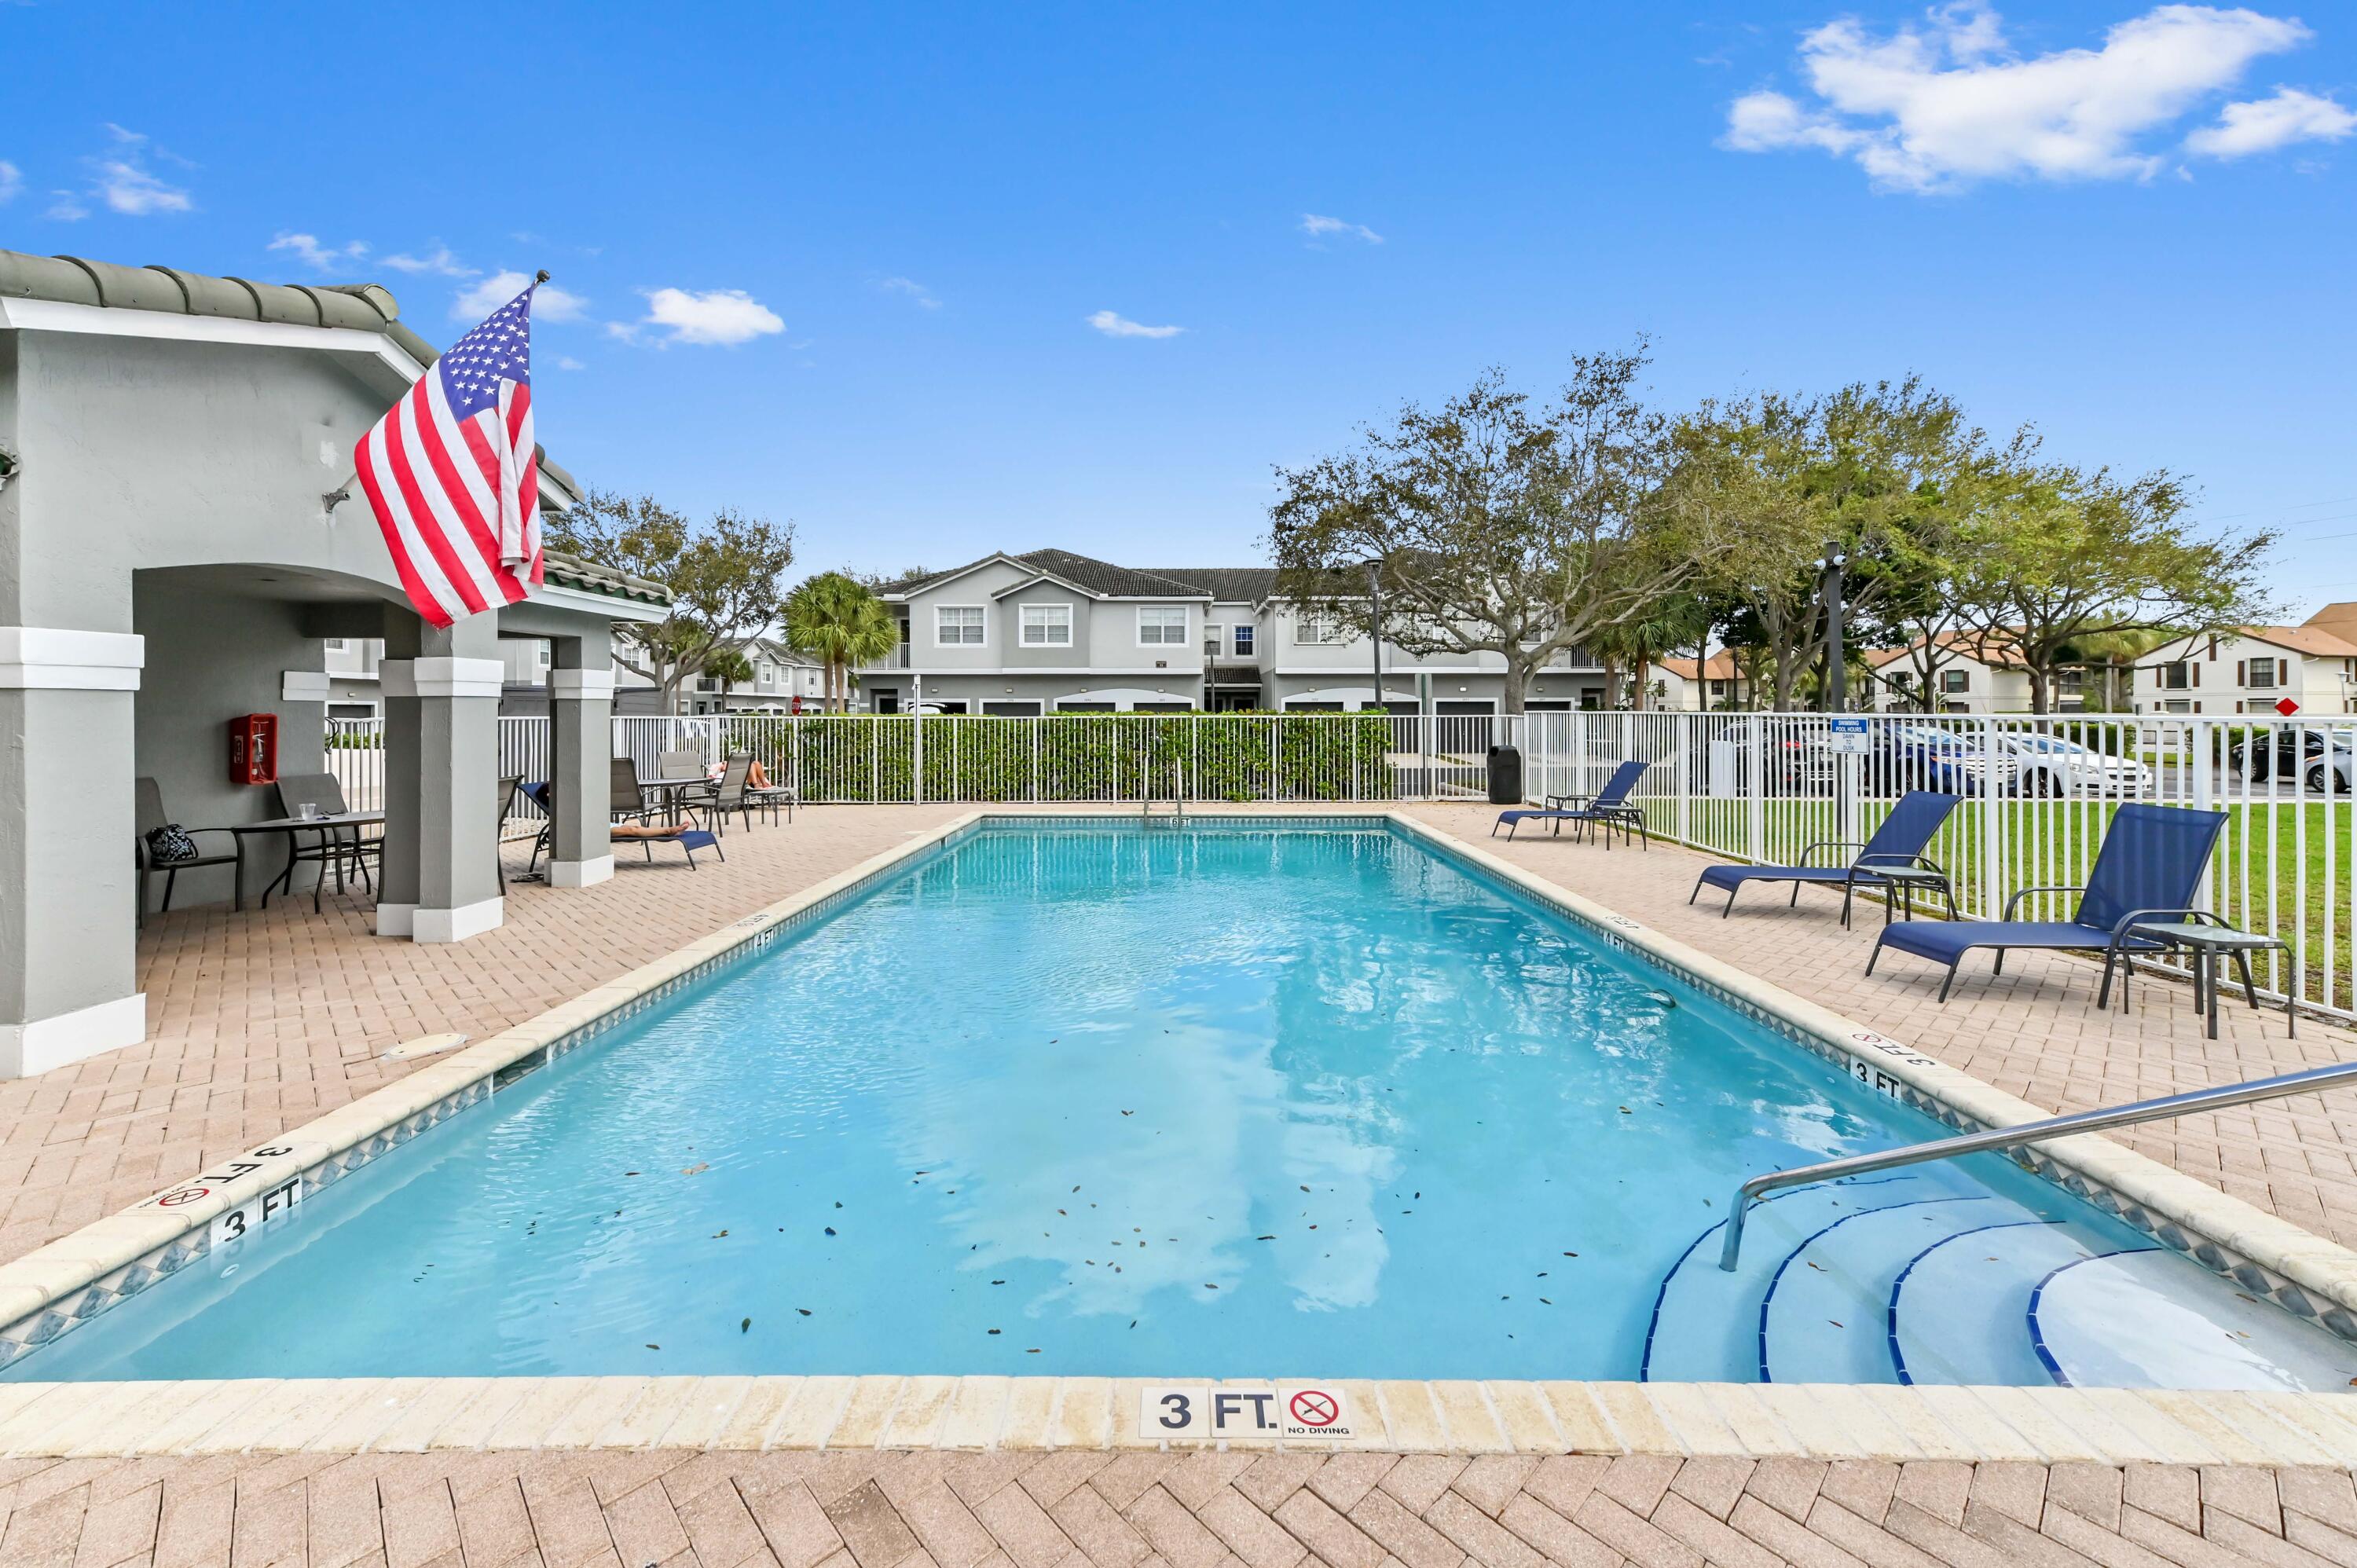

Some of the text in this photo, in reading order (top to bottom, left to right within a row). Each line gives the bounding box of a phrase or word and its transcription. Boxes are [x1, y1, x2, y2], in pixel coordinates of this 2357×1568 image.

[757, 935, 761, 946] 4
[1856, 1062, 1868, 1083] 3
[194, 1146, 293, 1184] 3 FT.
[224, 1210, 246, 1243] 3
[1159, 1394, 1277, 1429] 3 FT.
